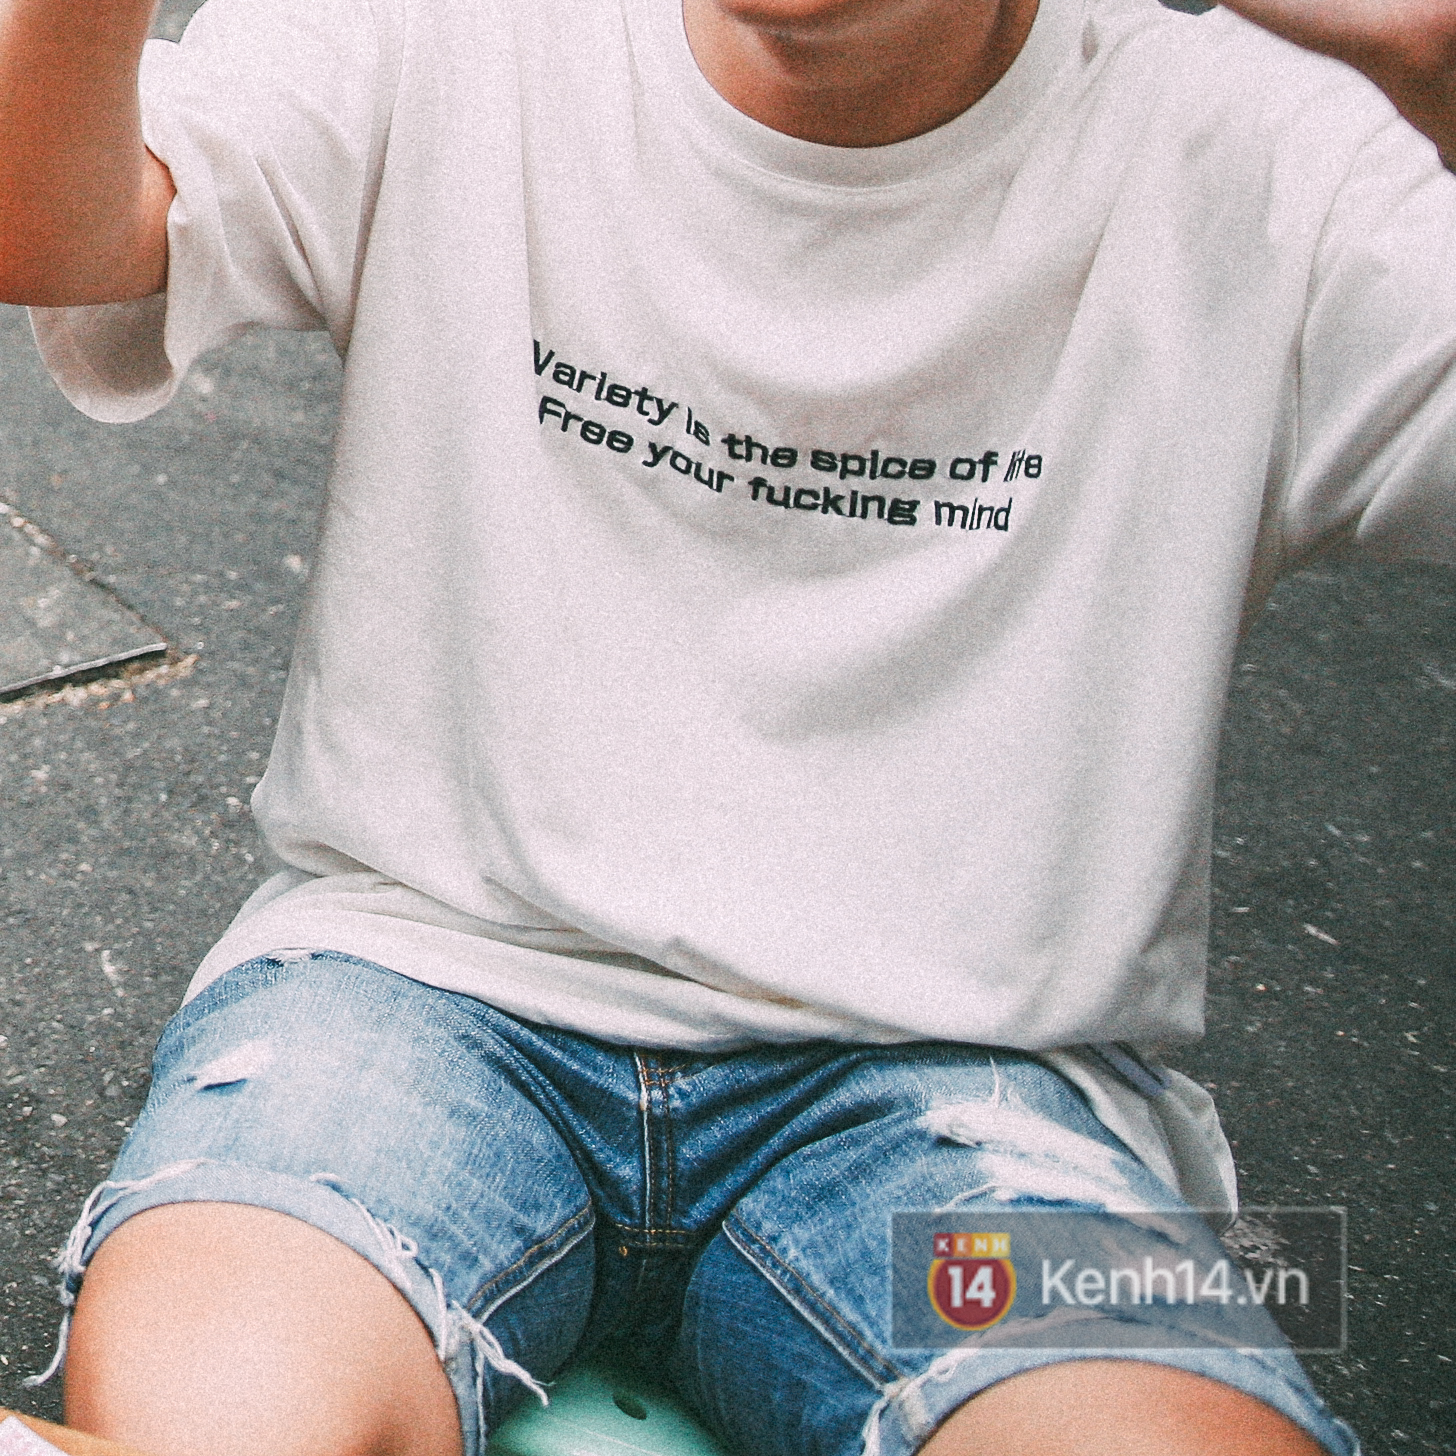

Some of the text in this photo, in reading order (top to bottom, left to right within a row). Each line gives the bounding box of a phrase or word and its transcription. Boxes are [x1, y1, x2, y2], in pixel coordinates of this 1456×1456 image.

[533, 339, 679, 426] Variety
[721, 432, 797, 468] the
[810, 448, 936, 482] spice
[949, 450, 998, 482] of
[538, 395, 1012, 532] Free your fucking mind
